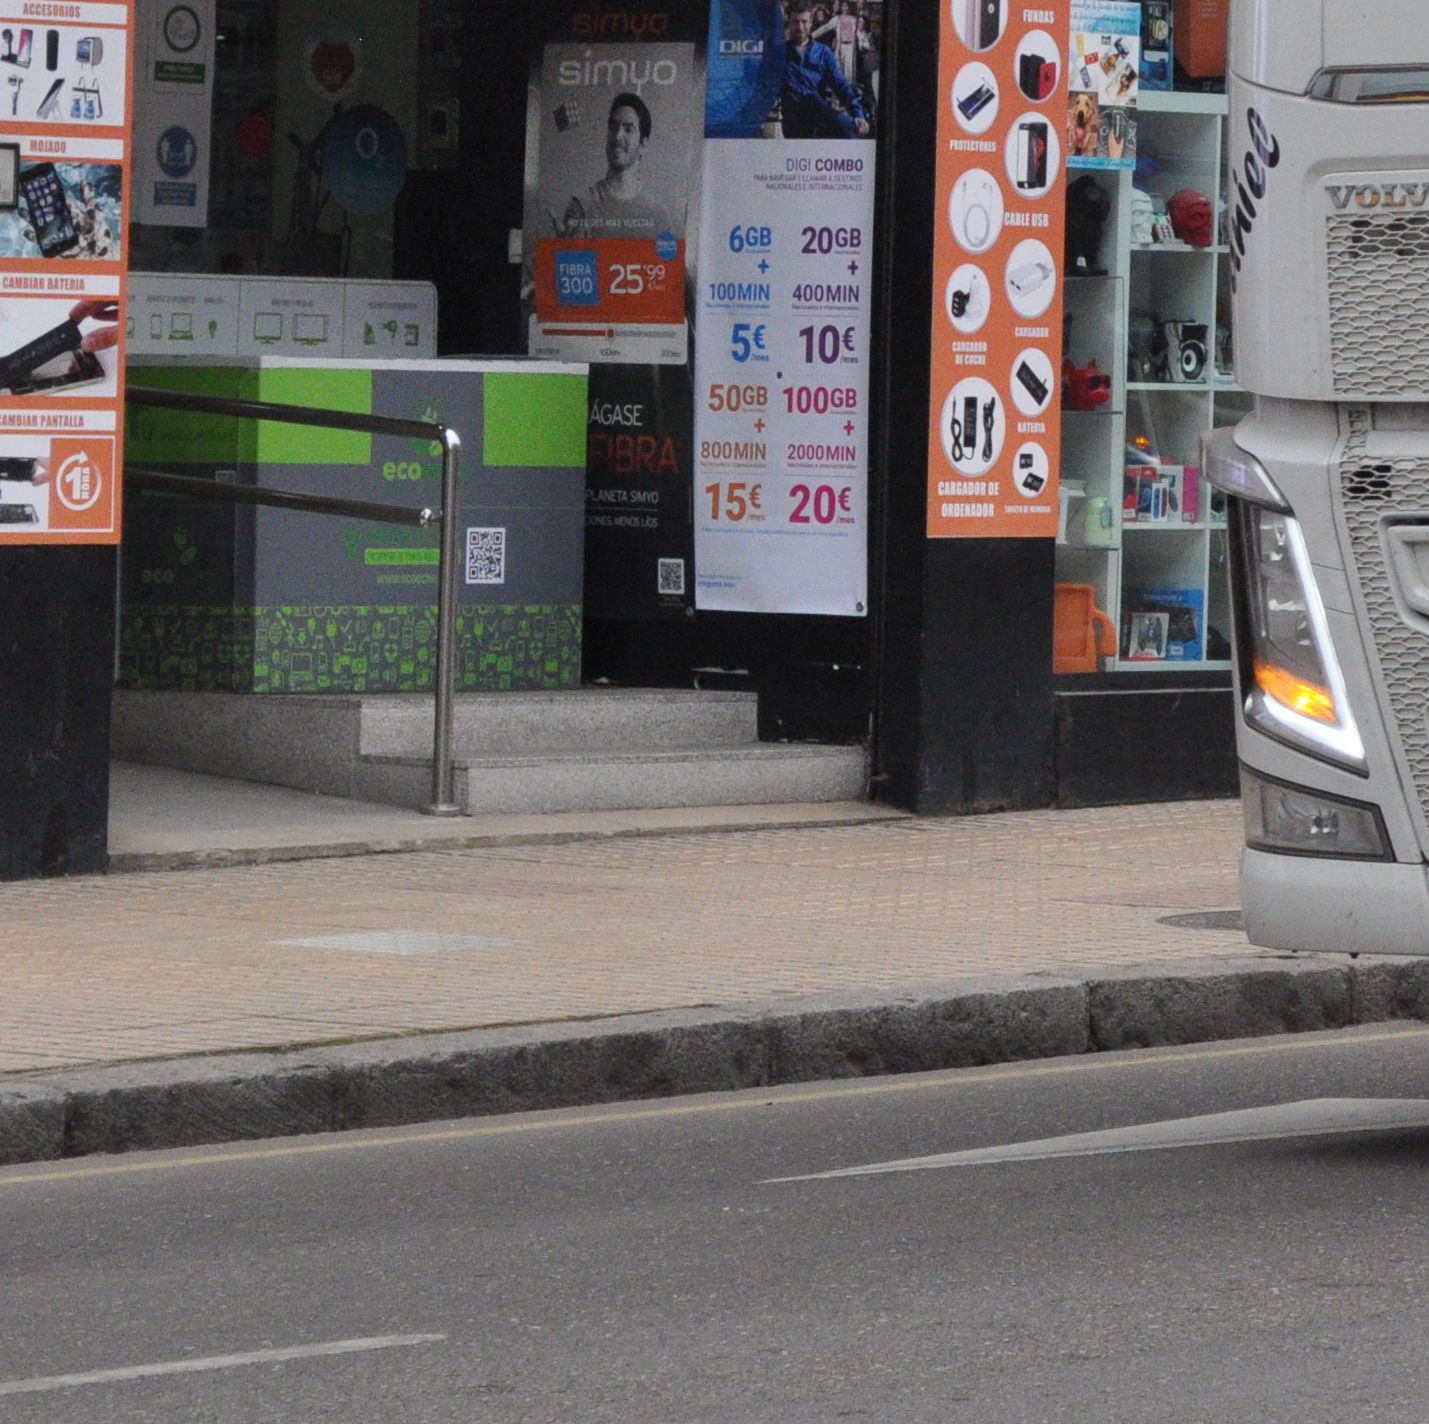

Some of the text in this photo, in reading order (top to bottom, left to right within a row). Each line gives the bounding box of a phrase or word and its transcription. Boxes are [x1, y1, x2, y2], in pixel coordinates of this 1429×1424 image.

[23, 2, 81, 18] ACCESORIOS
[1023, 9, 1055, 24] FUNDAS
[719, 40, 764, 54] DIGI
[559, 50, 677, 96] simyo
[30, 139, 66, 153] MOJADO
[949, 139, 997, 153] PROTECTORES
[786, 158, 863, 172] DIGI COMBO
[1004, 211, 1049, 228] CABLE USB
[729, 225, 861, 254] 6GB 20GB
[560, 264, 592, 275] FIBRA
[2, 276, 85, 292] CAMBIAR BATERIA
[561, 277, 593, 294] 300
[731, 323, 855, 364] 5€ 10€
[708, 384, 857, 414] 50GB 100GB
[40, 415, 85, 428] PANTALLA
[590, 433, 680, 474] FIBRA
[938, 481, 999, 496] CARGADOR DE
[630, 490, 659, 504] SIMYO
[705, 482, 852, 524] 15€ 20€
[941, 503, 994, 518] ORDENADOR
